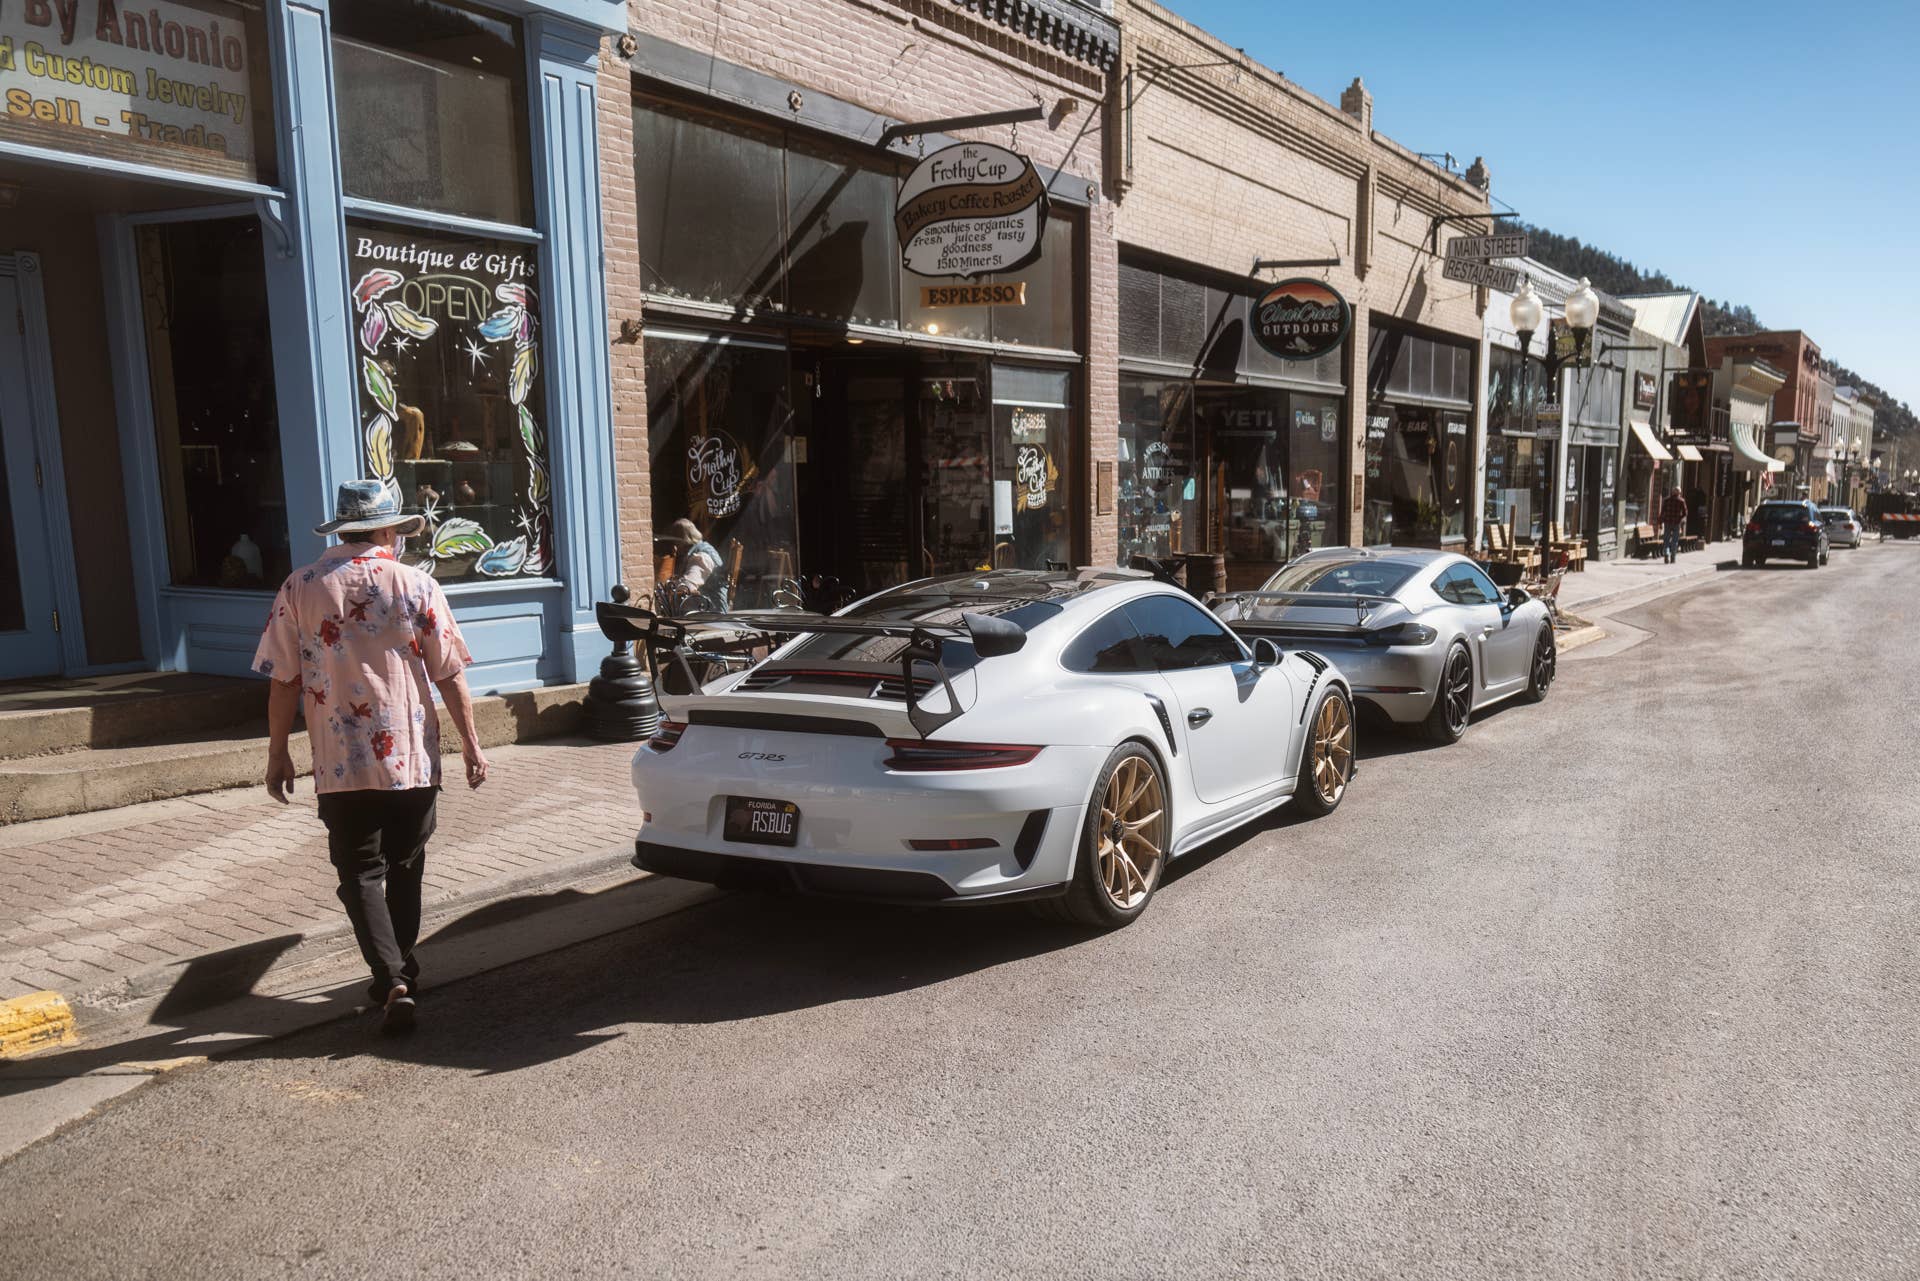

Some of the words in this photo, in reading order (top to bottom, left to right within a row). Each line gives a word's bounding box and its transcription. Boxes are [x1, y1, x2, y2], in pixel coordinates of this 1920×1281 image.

[96, 0, 243, 72] Antonio
[24, 41, 138, 97] Custom
[146, 67, 245, 125] Jewelry
[6, 88, 83, 127] Sell
[963, 147, 978, 159] the
[902, 200, 946, 229] Bakery
[949, 193, 991, 210] Coffee
[992, 175, 1035, 209] Roaster
[925, 221, 970, 236] smoothies
[974, 217, 1024, 233] organics
[914, 236, 942, 247] fresh
[953, 231, 986, 246] juices
[997, 231, 1026, 242] tasty
[1454, 239, 1481, 257] MAIN
[1483, 236, 1525, 255] STREET
[941, 242, 993, 257] goodness
[355, 238, 455, 274] Boutique
[460, 252, 483, 271] &
[485, 254, 535, 282] Gifts
[1446, 259, 1515, 290] RESTAURANT
[402, 280, 487, 321] OPEN
[928, 285, 1016, 304] ESPRESSO
[1263, 322, 1339, 336] OUTDOORS
[1221, 409, 1273, 428] YETI
[1142, 466, 1176, 480] ANTIQUES
[706, 491, 741, 507] COFFEE
[748, 800, 777, 810] FLORIDA
[751, 811, 793, 834] RSBUG
